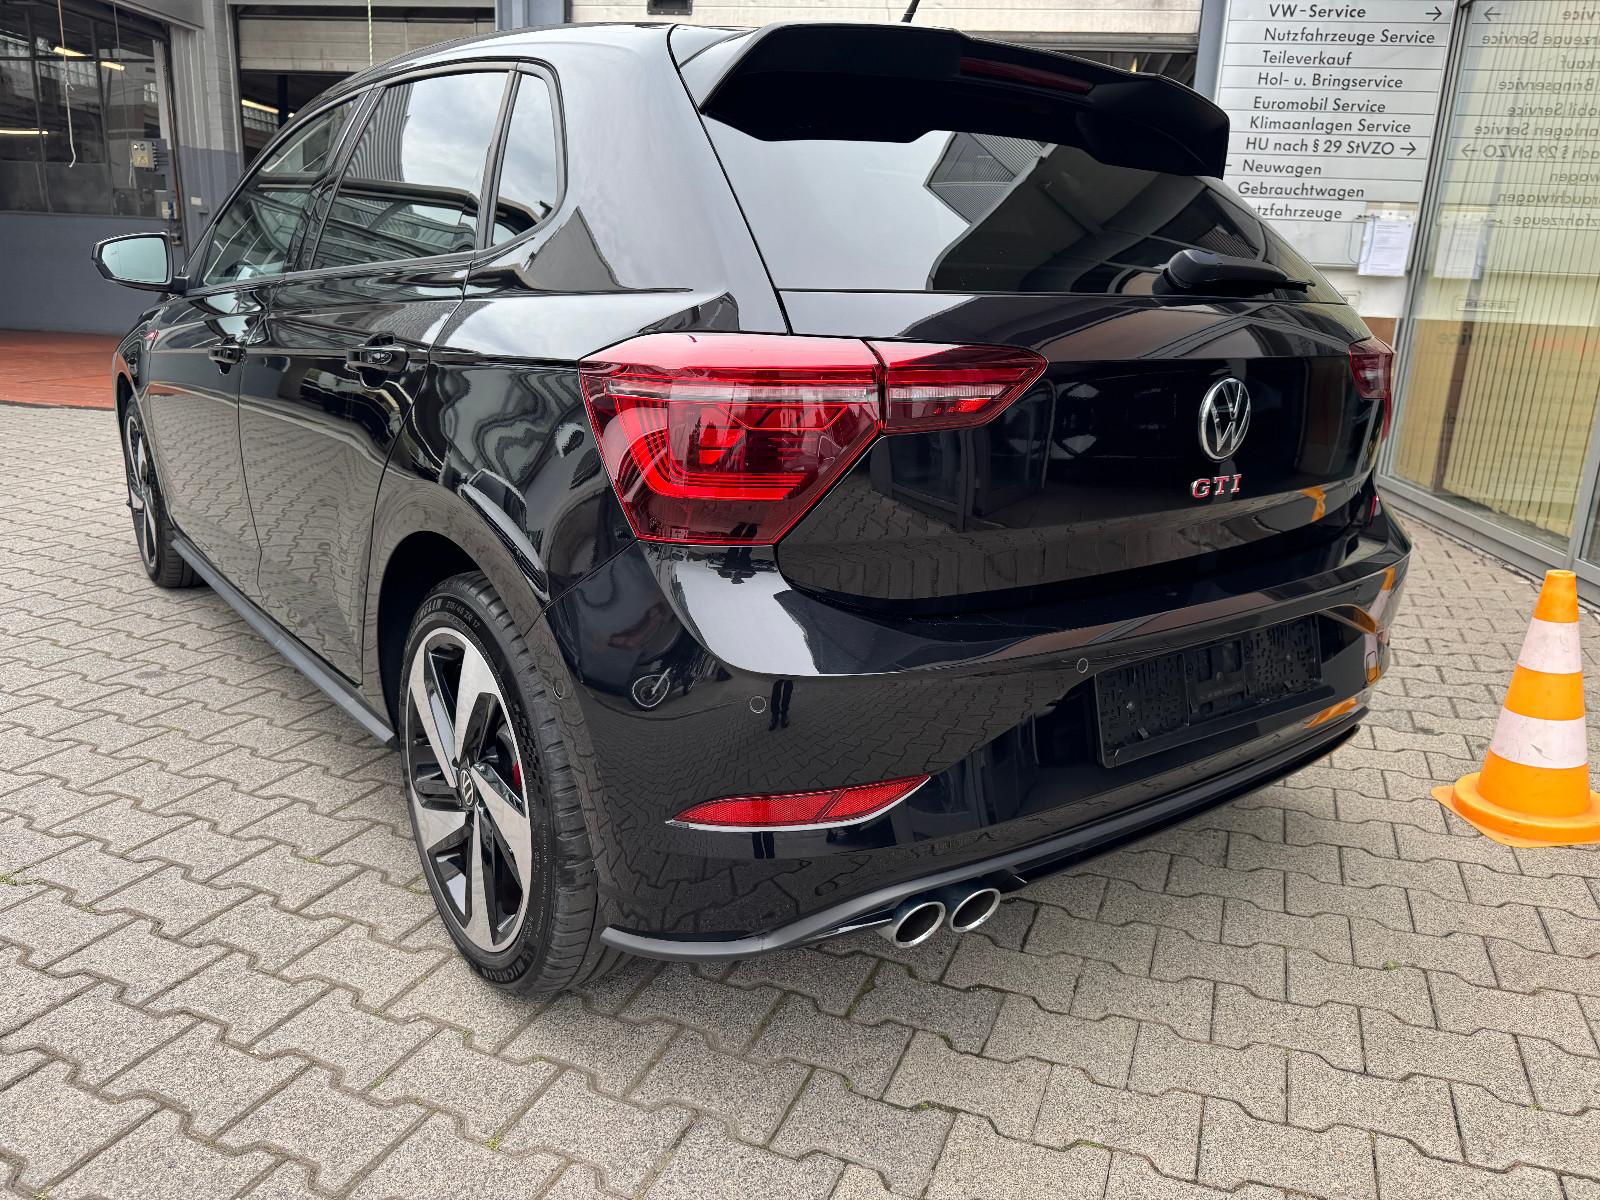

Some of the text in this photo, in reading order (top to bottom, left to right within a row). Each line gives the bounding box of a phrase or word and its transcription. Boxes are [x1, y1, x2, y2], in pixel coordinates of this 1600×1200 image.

[1264, 27, 1435, 45] Nutzfahrzeuge Service
[1262, 50, 1352, 66] Teileverkauf
[1257, 72, 1403, 90] Hol- u. Bringservice
[1253, 96, 1386, 113] Euromobil Service
[1250, 116, 1411, 134] Klimaanlagen Service
[1246, 137, 1394, 155] HU nach § 29 StVZO
[1243, 159, 1321, 177] Neuwagen
[1238, 182, 1364, 200] Gebrauchtwagen
[1253, 203, 1342, 221] tzfahrzeuge
[1190, 473, 1242, 499] GTI
